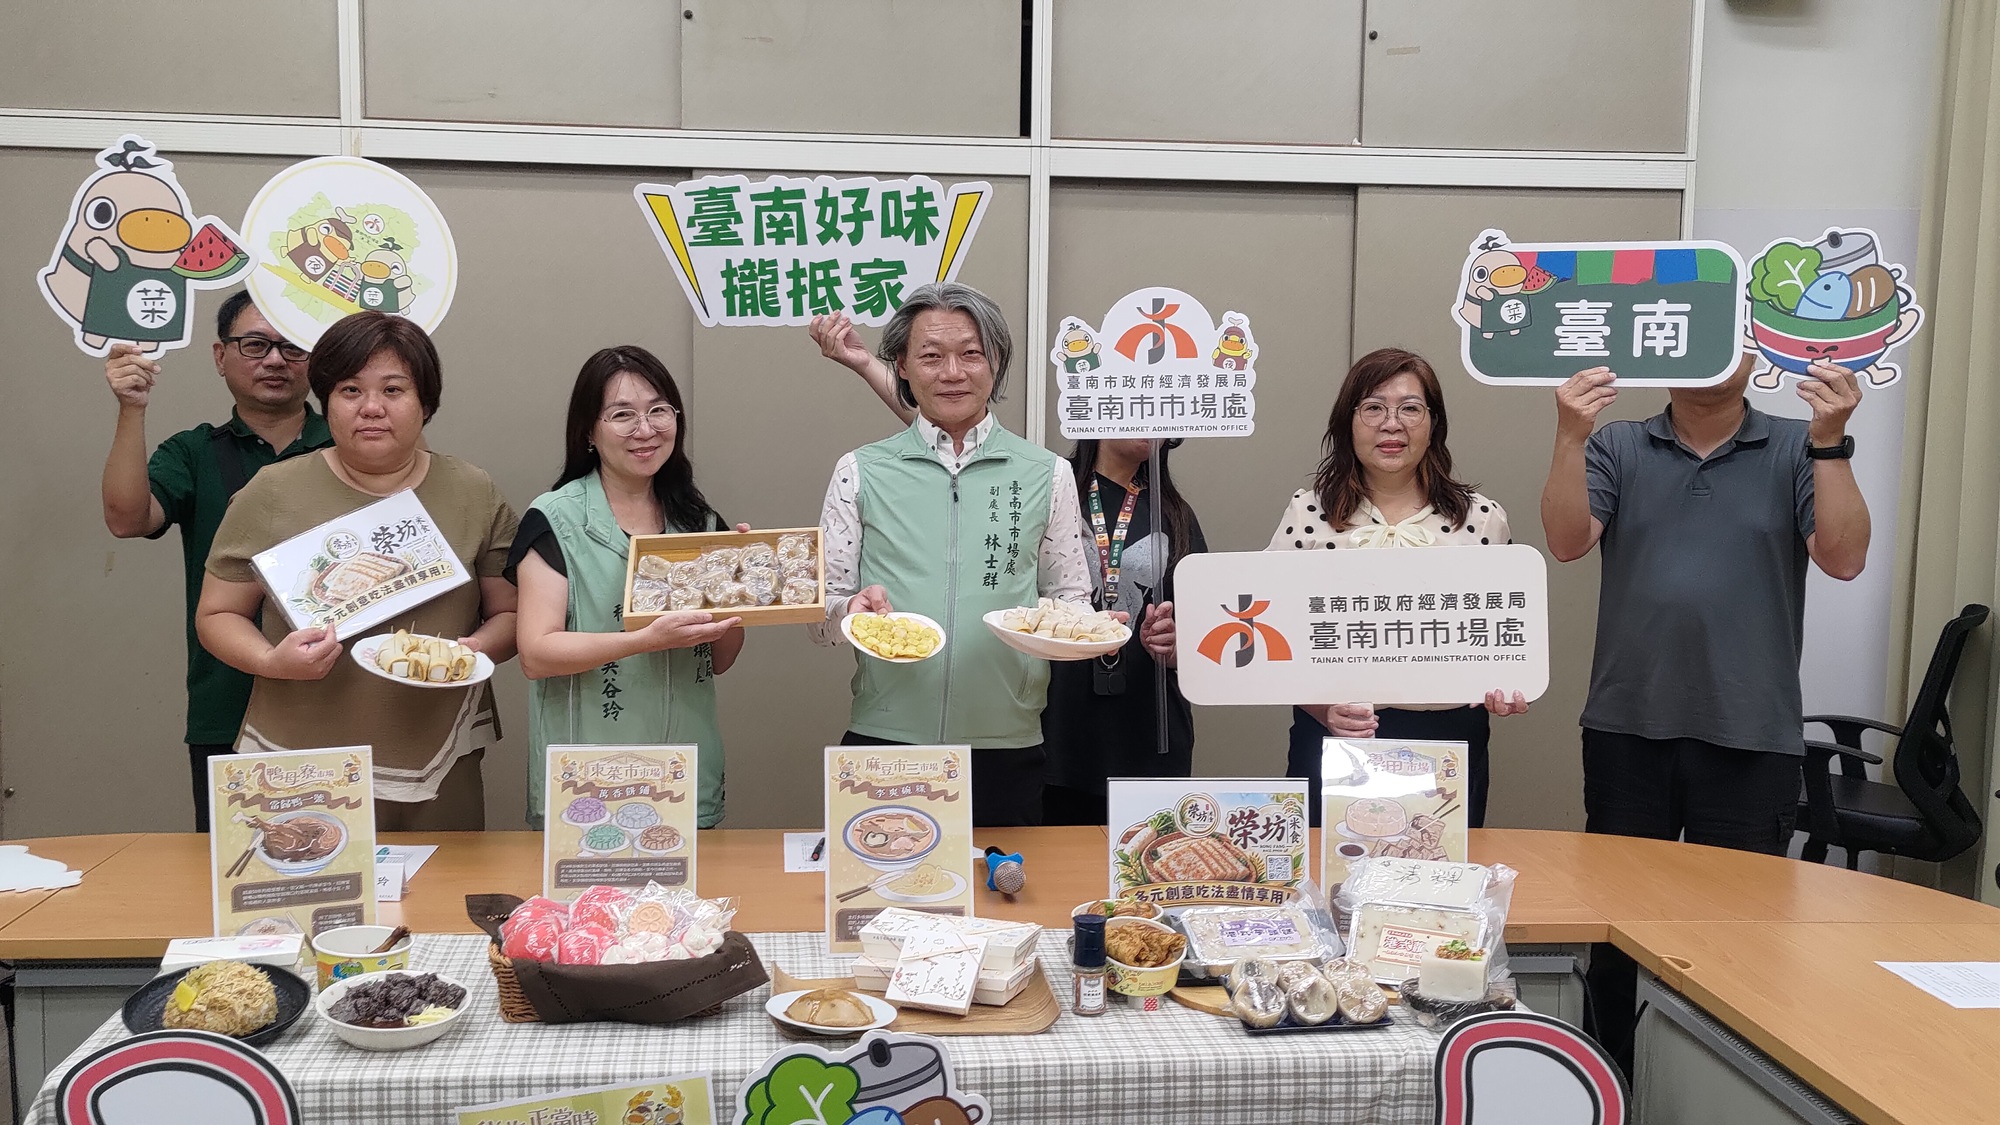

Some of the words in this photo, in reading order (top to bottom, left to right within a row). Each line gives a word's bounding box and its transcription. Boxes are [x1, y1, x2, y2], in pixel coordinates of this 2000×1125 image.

[684, 186, 940, 247] 臺南好味
[720, 258, 908, 317] 攏抵家
[136, 288, 171, 323] 菜
[1505, 302, 1523, 321] 菜
[1553, 299, 1692, 357] 臺南
[1067, 374, 1247, 390] 臺南市政府經濟發展局
[1066, 393, 1248, 421] 臺南市市場處
[988, 486, 1000, 522] 副處長
[371, 519, 417, 555] 榮坊
[1003, 481, 1022, 576] 臺南市市場處
[982, 533, 1002, 590] 林士群
[1308, 592, 1526, 614] 臺南市政府經濟發展局
[1309, 618, 1526, 650] 臺南市市場處
[1311, 656, 1343, 664] TAINAN
[1372, 655, 1408, 663] MARKET
[1411, 654, 1490, 662] ADMINISTRATION
[1228, 809, 1288, 850] 榮坊
[1289, 817, 1301, 843] 米食
[1135, 885, 1291, 905] 多元創意吃法盡情享用!
[478, 1107, 597, 1125] 正當時
